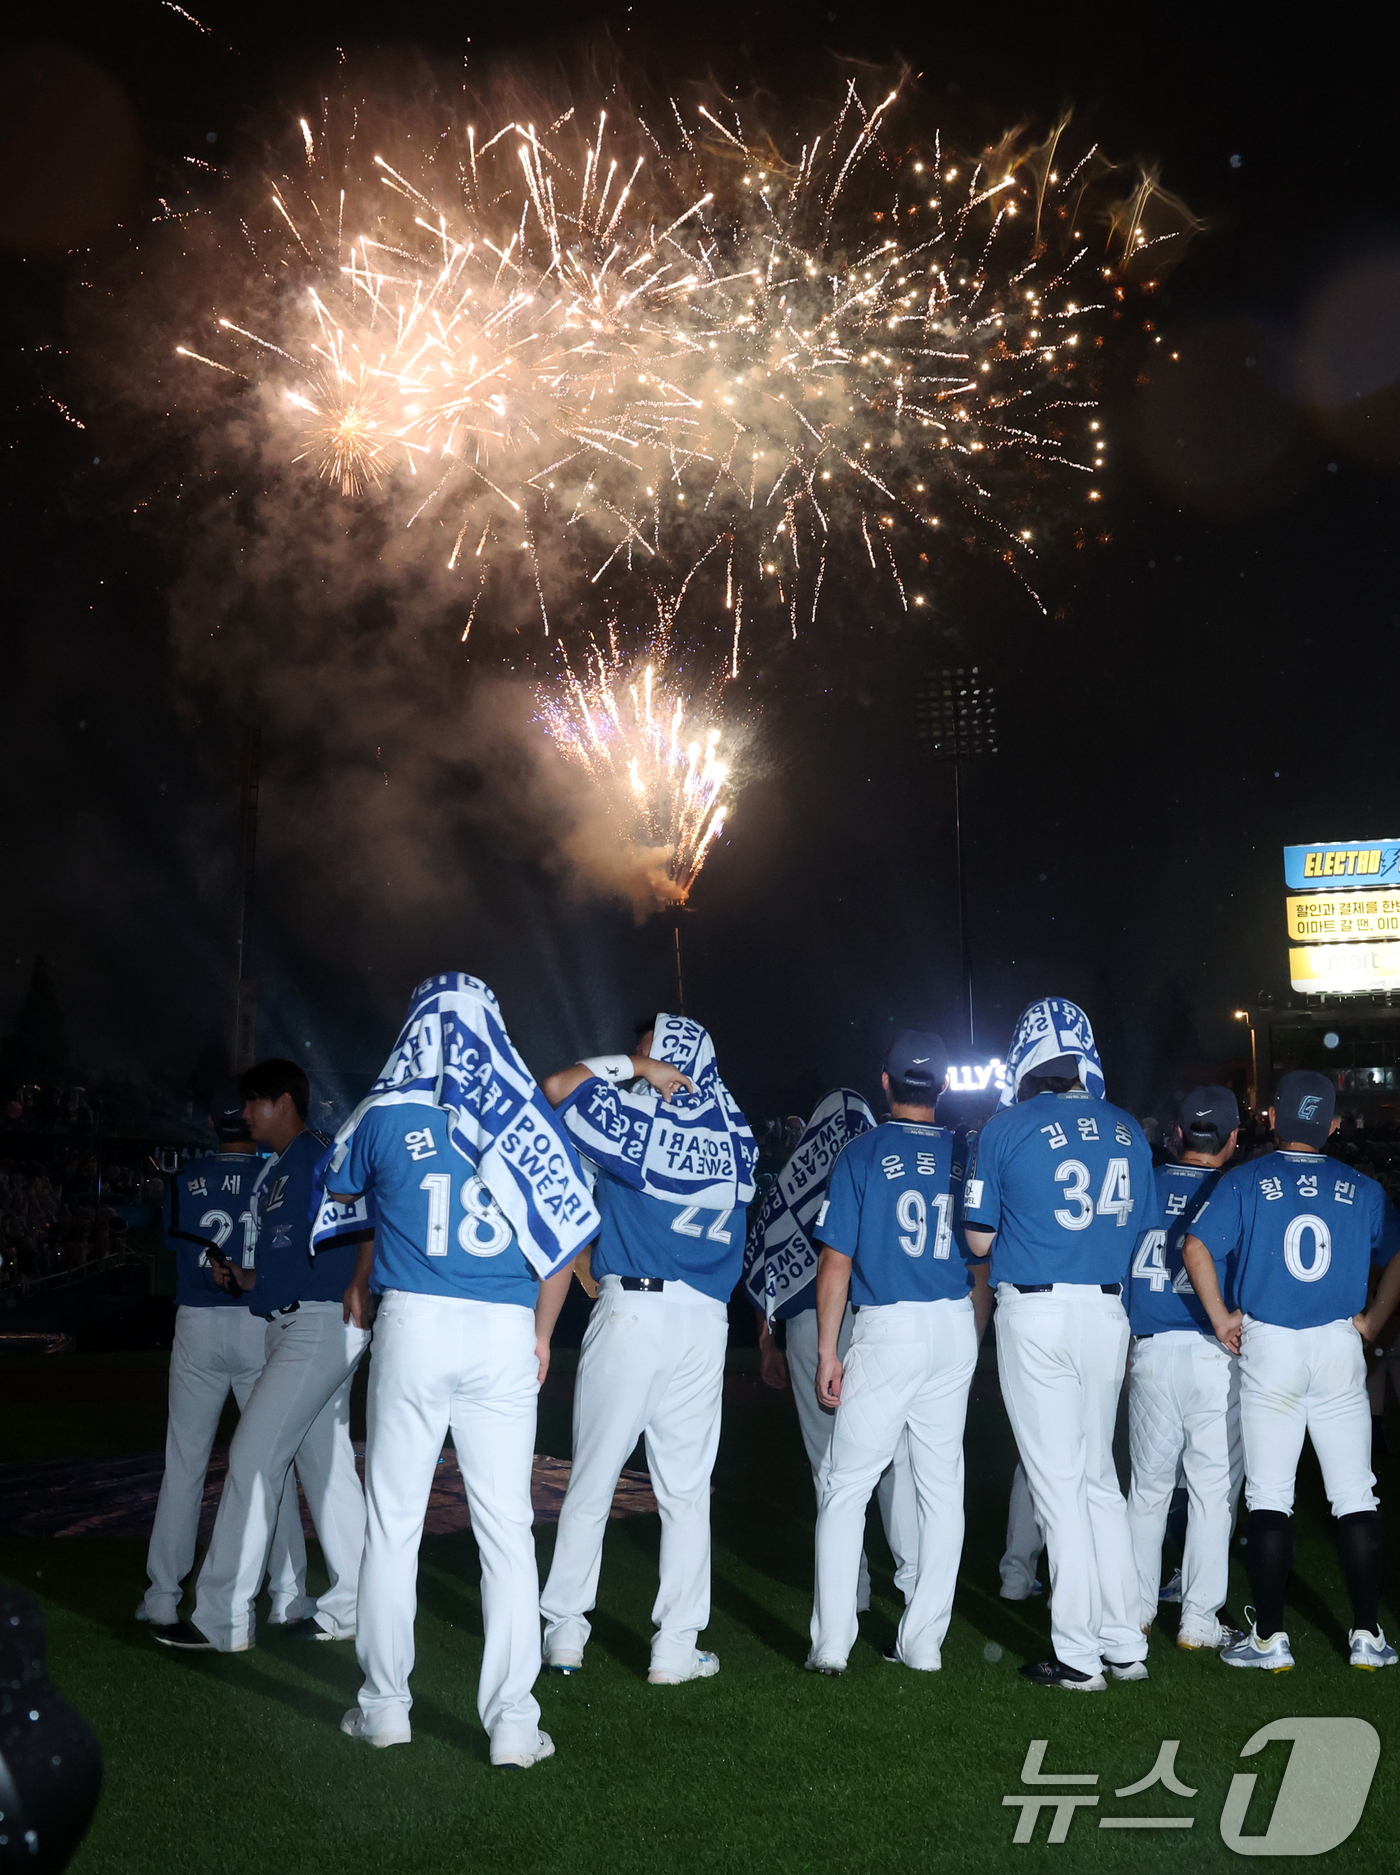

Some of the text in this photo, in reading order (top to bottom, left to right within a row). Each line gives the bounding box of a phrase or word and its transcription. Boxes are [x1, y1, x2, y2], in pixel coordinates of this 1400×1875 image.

[1304, 849, 1382, 878] ELECTRO
[1296, 902, 1335, 918] 할인과
[1339, 901, 1378, 915] 결제를
[1297, 919, 1336, 934] 이마트
[1340, 918, 1353, 933] 갈
[515, 1115, 592, 1226] POCARI
[791, 1114, 846, 1178] SWEAT
[419, 1173, 513, 1258] 18
[896, 1189, 955, 1260] 91
[1054, 1157, 1135, 1231] 34
[198, 1208, 259, 1270] 21
[1283, 1213, 1332, 1282] 0
